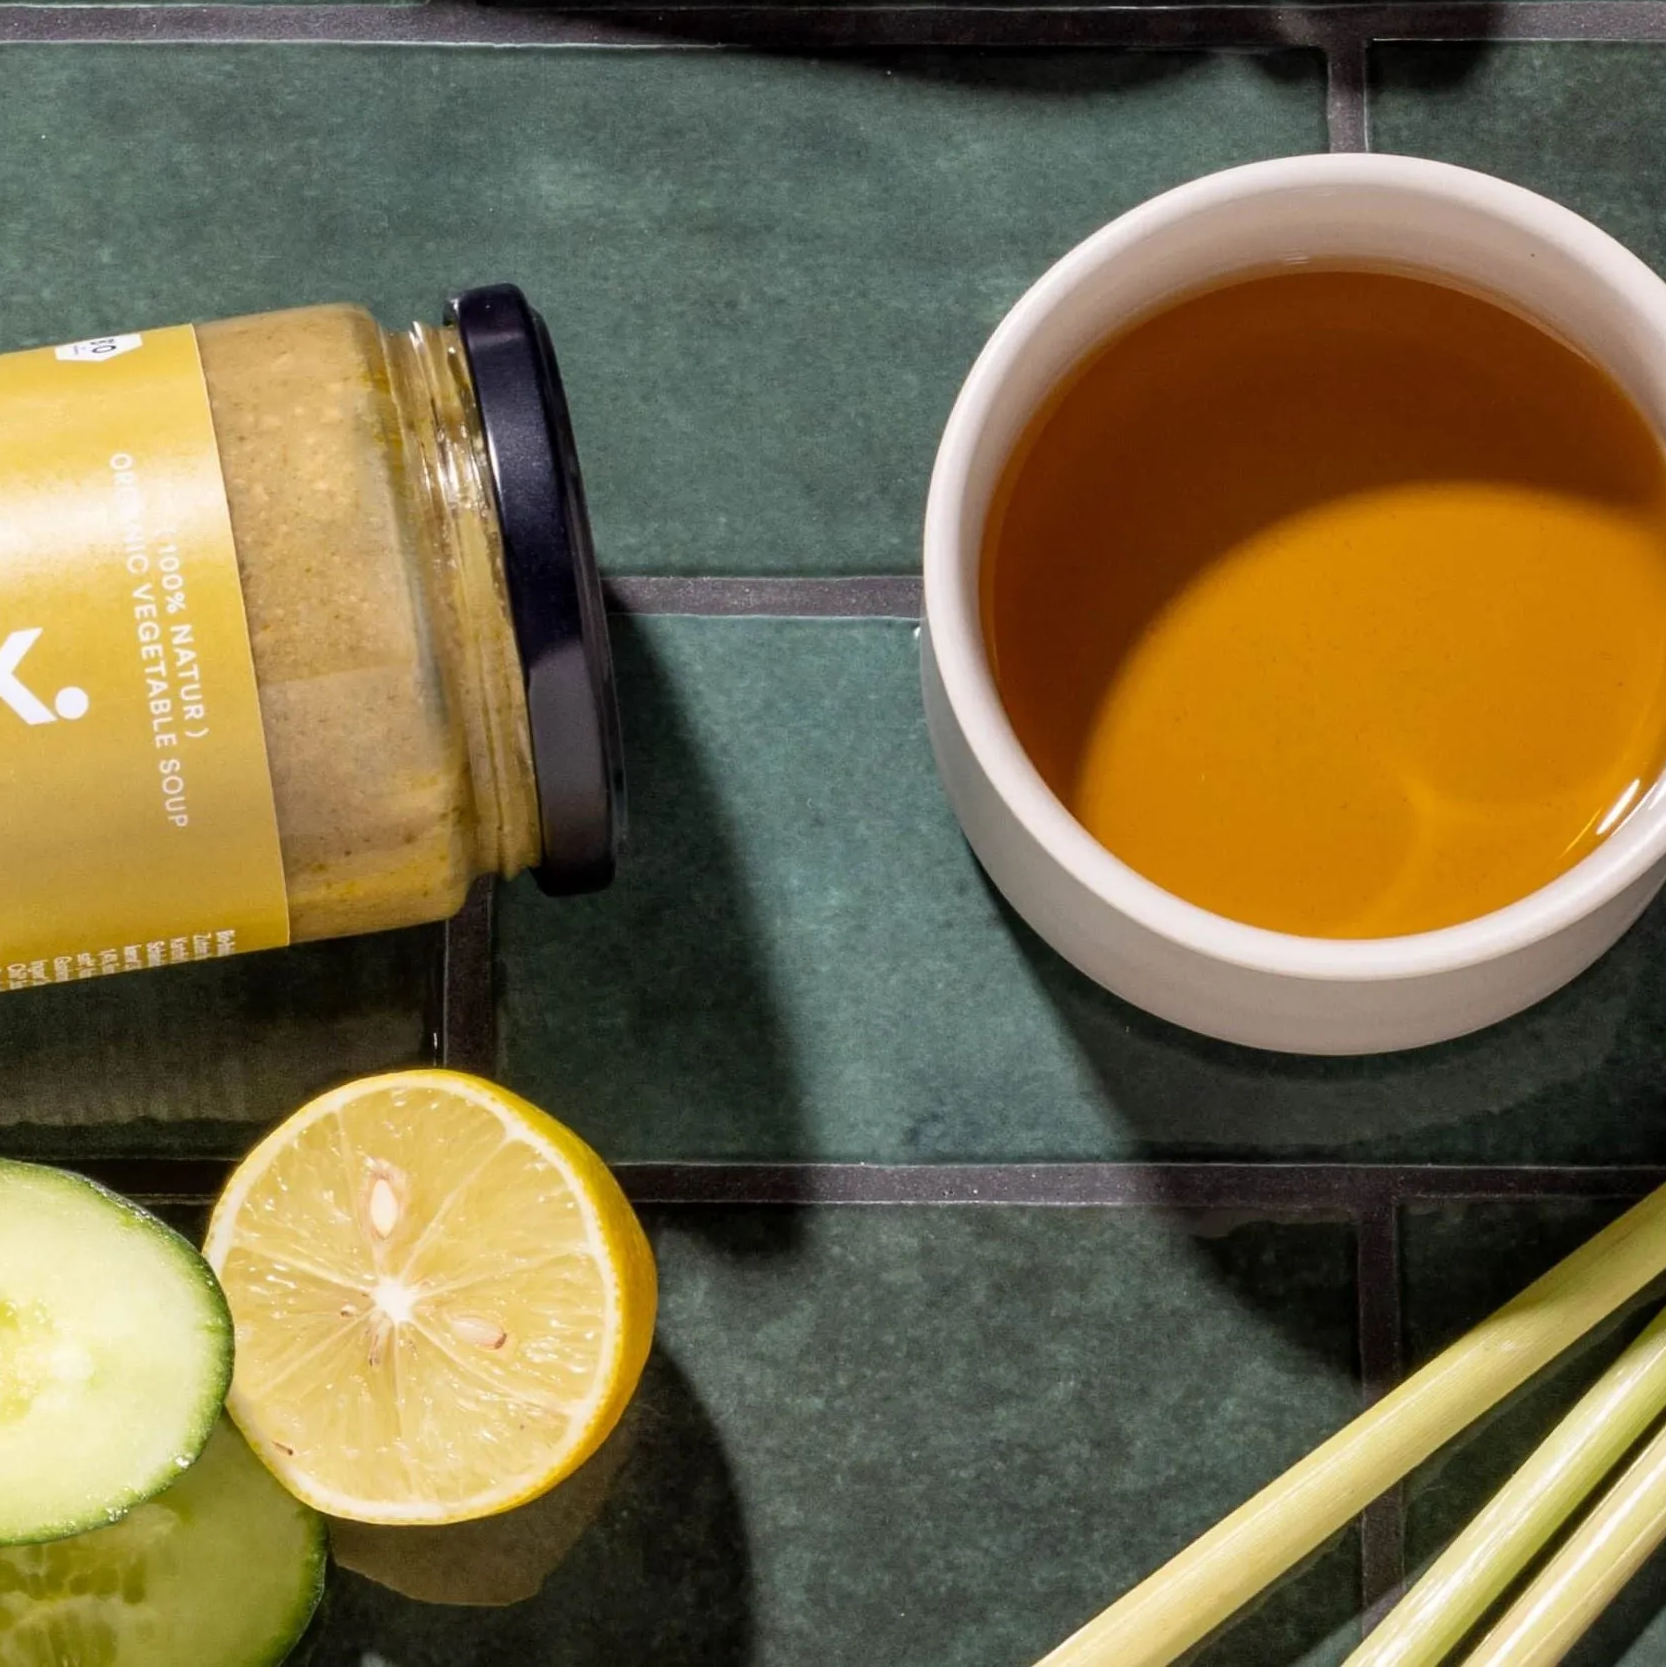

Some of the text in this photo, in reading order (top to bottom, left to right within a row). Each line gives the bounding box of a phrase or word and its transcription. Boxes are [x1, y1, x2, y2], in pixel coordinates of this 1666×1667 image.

[155, 543, 188, 615] 100%
[127, 581, 178, 750] VEGETABLE
[156, 756, 190, 830] SOUP
[168, 621, 206, 722] NATUR
